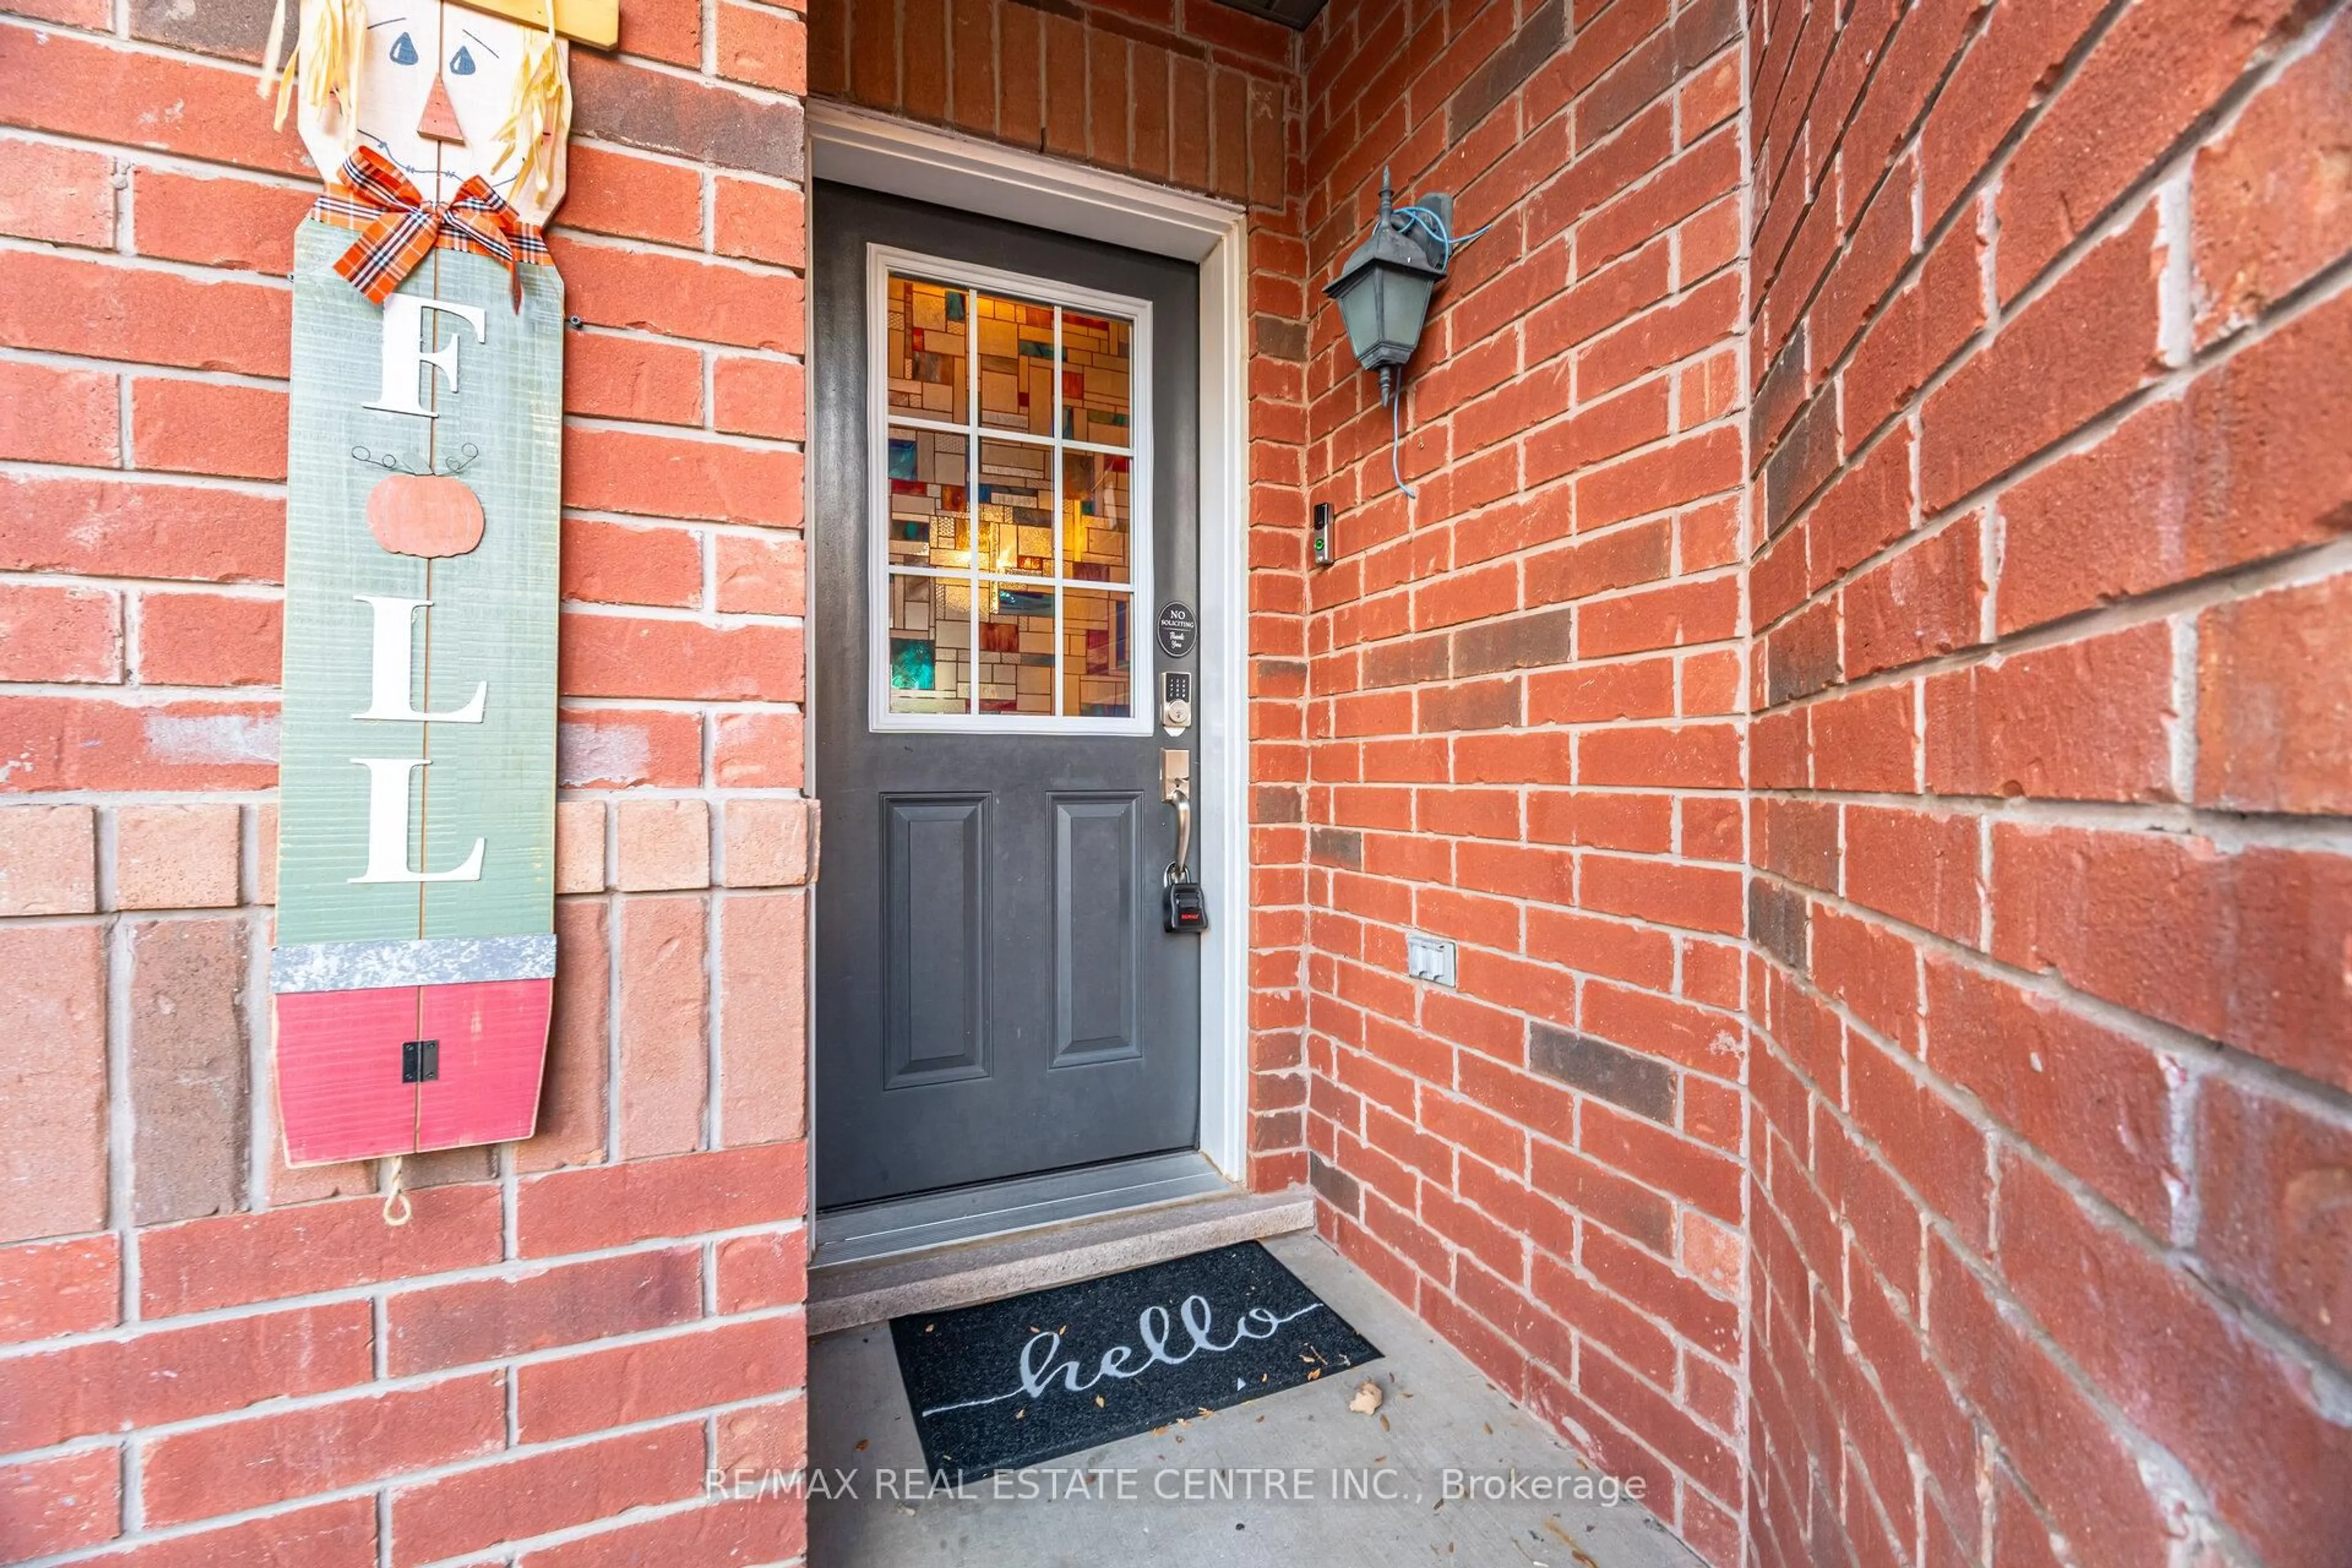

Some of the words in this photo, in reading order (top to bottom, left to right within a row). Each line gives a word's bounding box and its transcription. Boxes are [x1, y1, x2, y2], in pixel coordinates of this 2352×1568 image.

[1170, 610, 1186, 619] NO
[1161, 619, 1194, 628] SOLICITING
[922, 1295, 1324, 1417] hello
